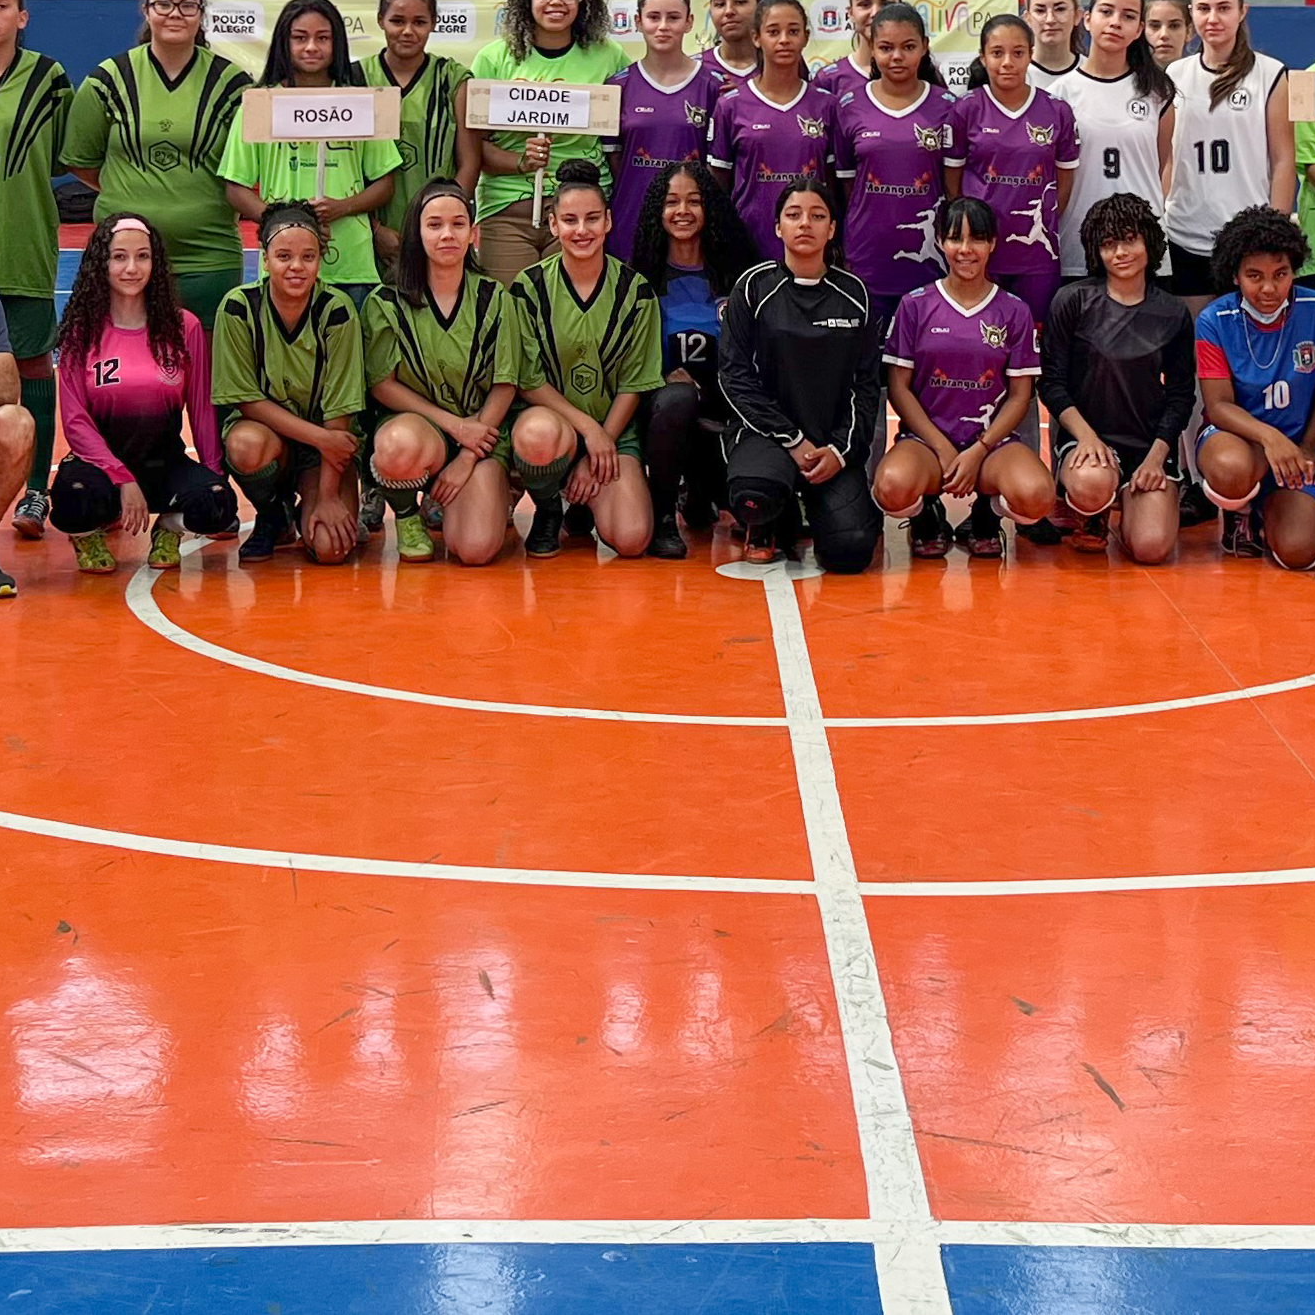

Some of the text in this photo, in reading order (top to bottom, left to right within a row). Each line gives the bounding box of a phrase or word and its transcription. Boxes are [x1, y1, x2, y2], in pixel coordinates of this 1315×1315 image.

[212, 15, 255, 24] POUSO
[436, 15, 467, 24] OUSO
[212, 25, 255, 34] ALEGRE
[509, 87, 571, 103] CIDADE
[294, 106, 353, 123] ROSÃO
[507, 110, 569, 125] JARDIM
[1103, 147, 1120, 179] 9
[1194, 139, 1230, 174] 10
[676, 333, 707, 363] 12
[92, 357, 121, 388] 12
[1262, 380, 1290, 410] 10
